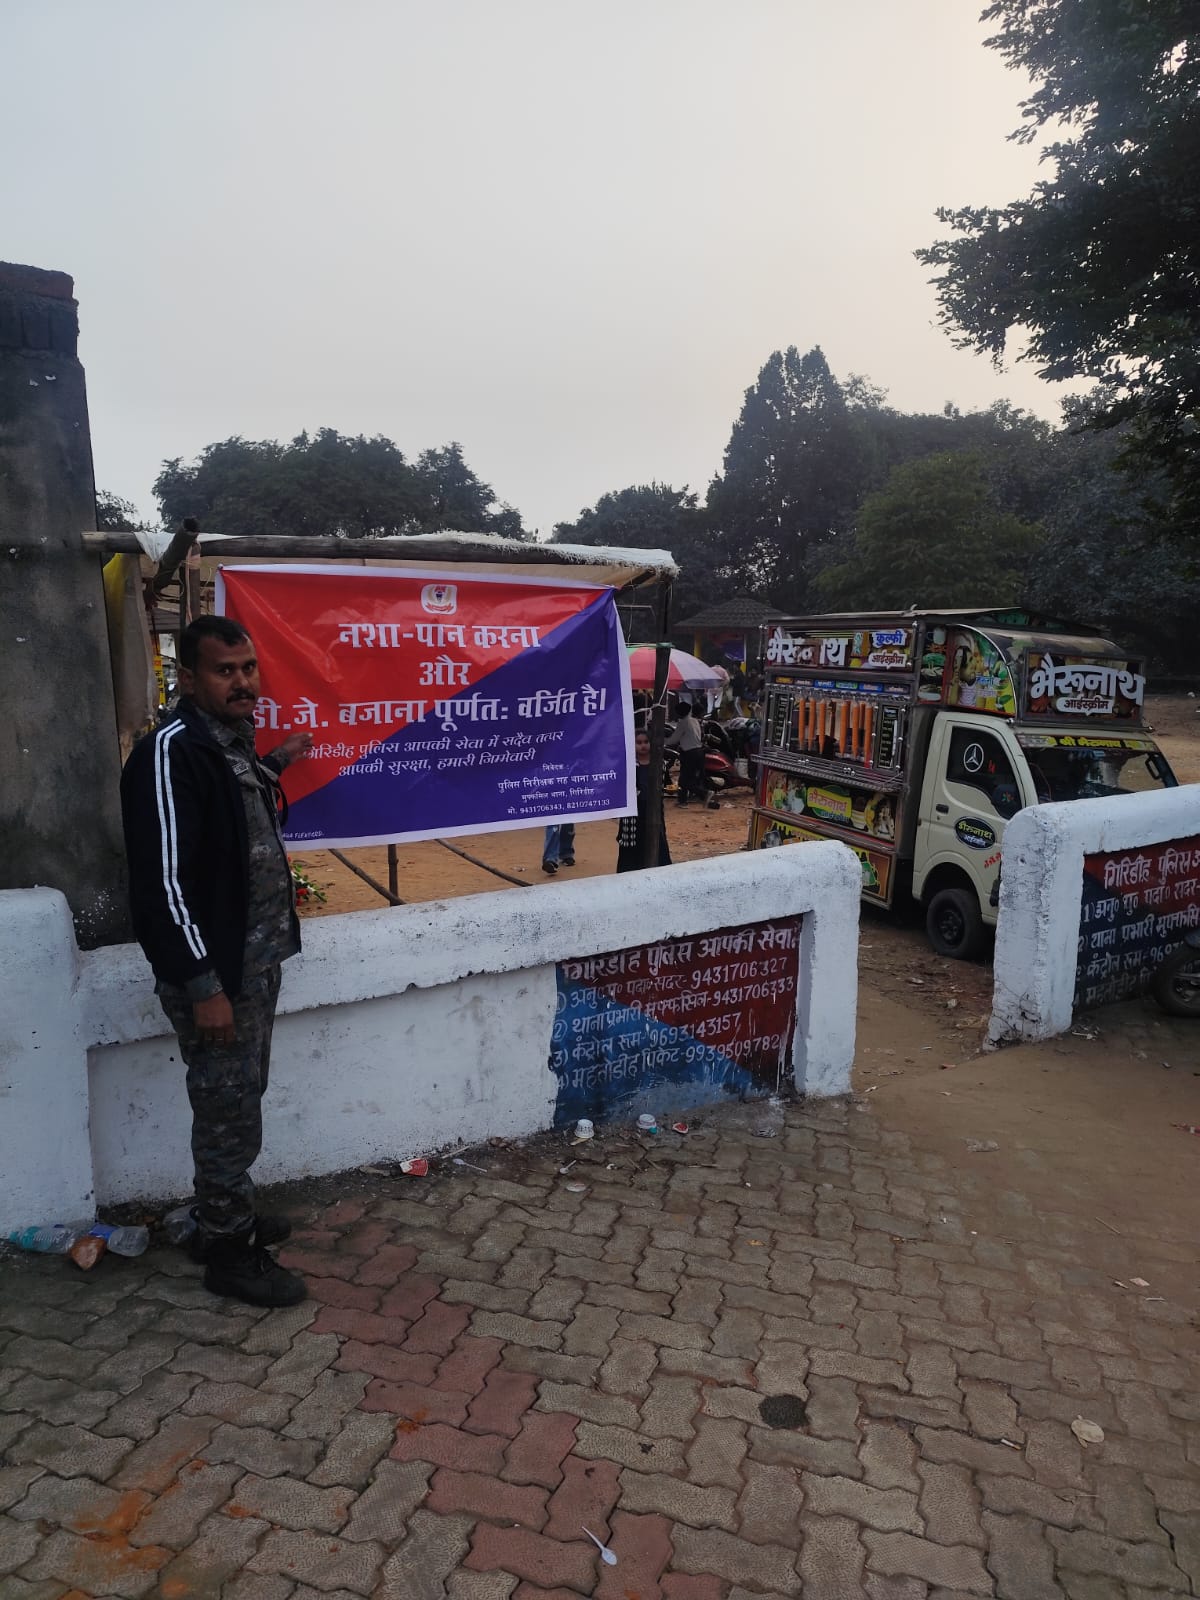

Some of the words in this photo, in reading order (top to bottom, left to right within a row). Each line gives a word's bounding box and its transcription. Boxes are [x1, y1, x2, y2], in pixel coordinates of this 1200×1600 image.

[338, 623, 466, 648] नशा-पान
[471, 625, 541, 648] करना
[875, 631, 904, 646] कुल्फी
[419, 654, 472, 686] और
[338, 699, 428, 726] बजाना
[517, 687, 578, 719] वर्जित
[359, 739, 400, 759] पुलिस
[404, 736, 450, 753] आपकी
[455, 735, 484, 751] सेवा
[488, 734, 501, 749] में
[502, 731, 533, 747] सदैव
[536, 730, 564, 744] तत्पर
[338, 758, 384, 777] आपकी
[388, 757, 431, 775] सुरक्षा,
[437, 753, 476, 770] हमारी
[479, 748, 537, 765] जिम्मेवारी
[1104, 854, 1152, 890] गिरिडीह
[1158, 848, 1192, 885] पुलिस
[697, 929, 756, 957] आपकी
[691, 957, 787, 990] 9431706327
[649, 1011, 742, 1048] 9693143157
